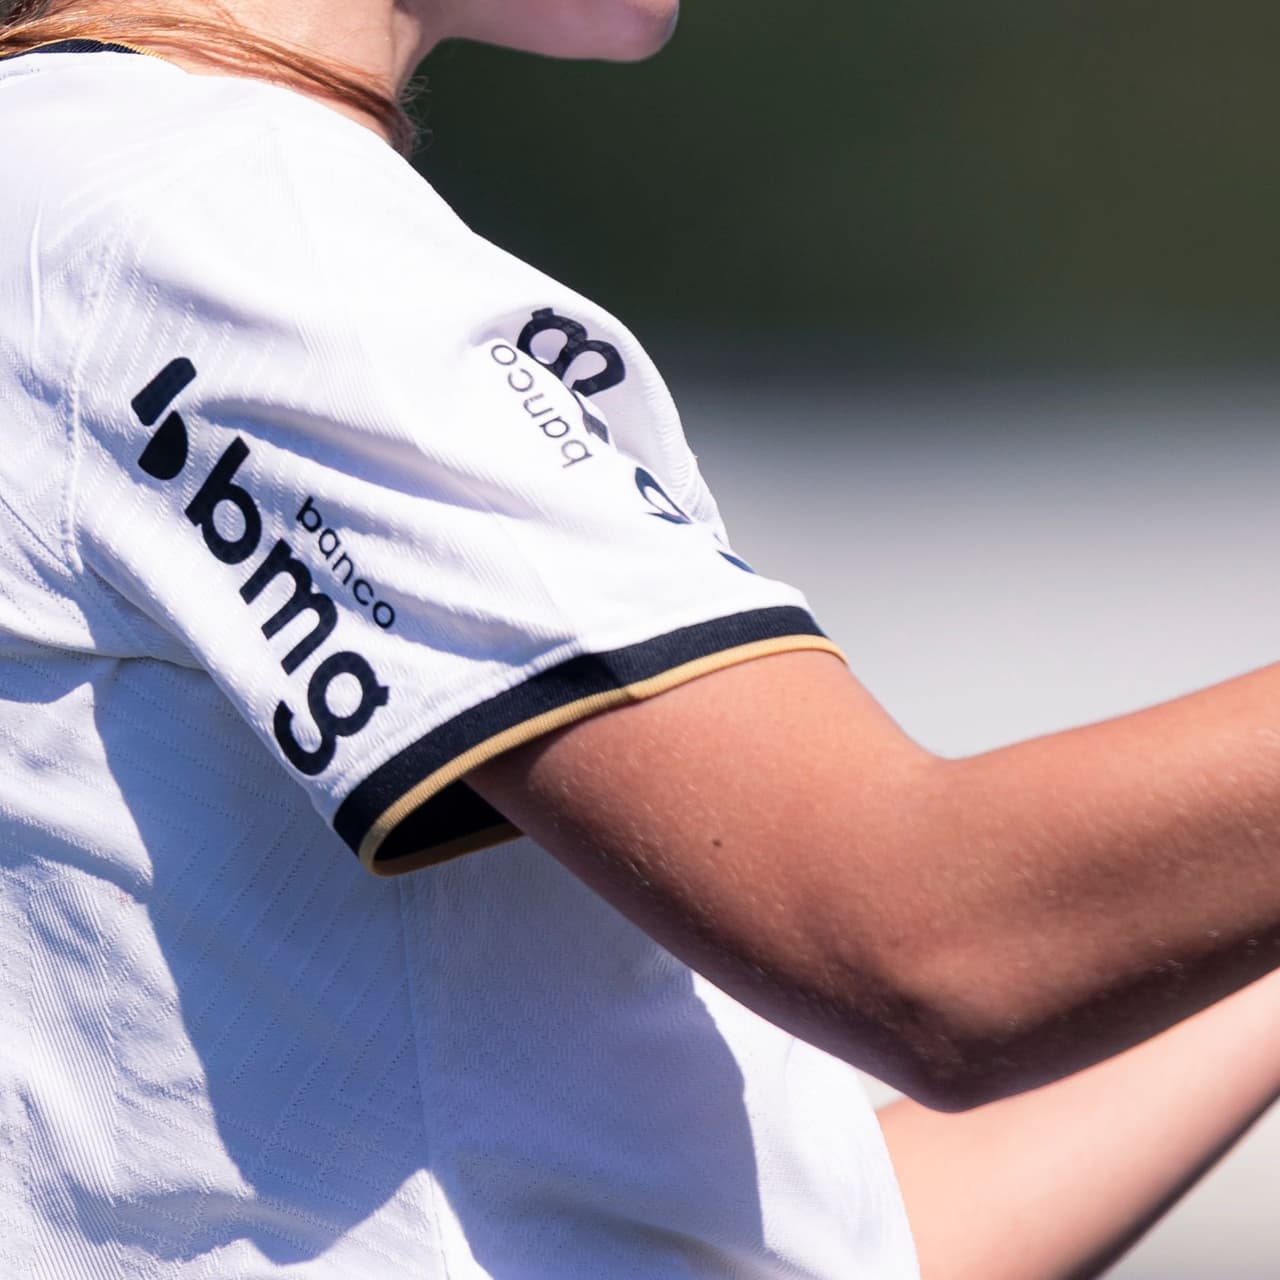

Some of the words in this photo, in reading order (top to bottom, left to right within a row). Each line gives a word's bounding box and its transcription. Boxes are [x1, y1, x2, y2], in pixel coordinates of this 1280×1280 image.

[490, 344, 593, 469] banco
[183, 436, 390, 777] bmg
[295, 496, 396, 630] banco
